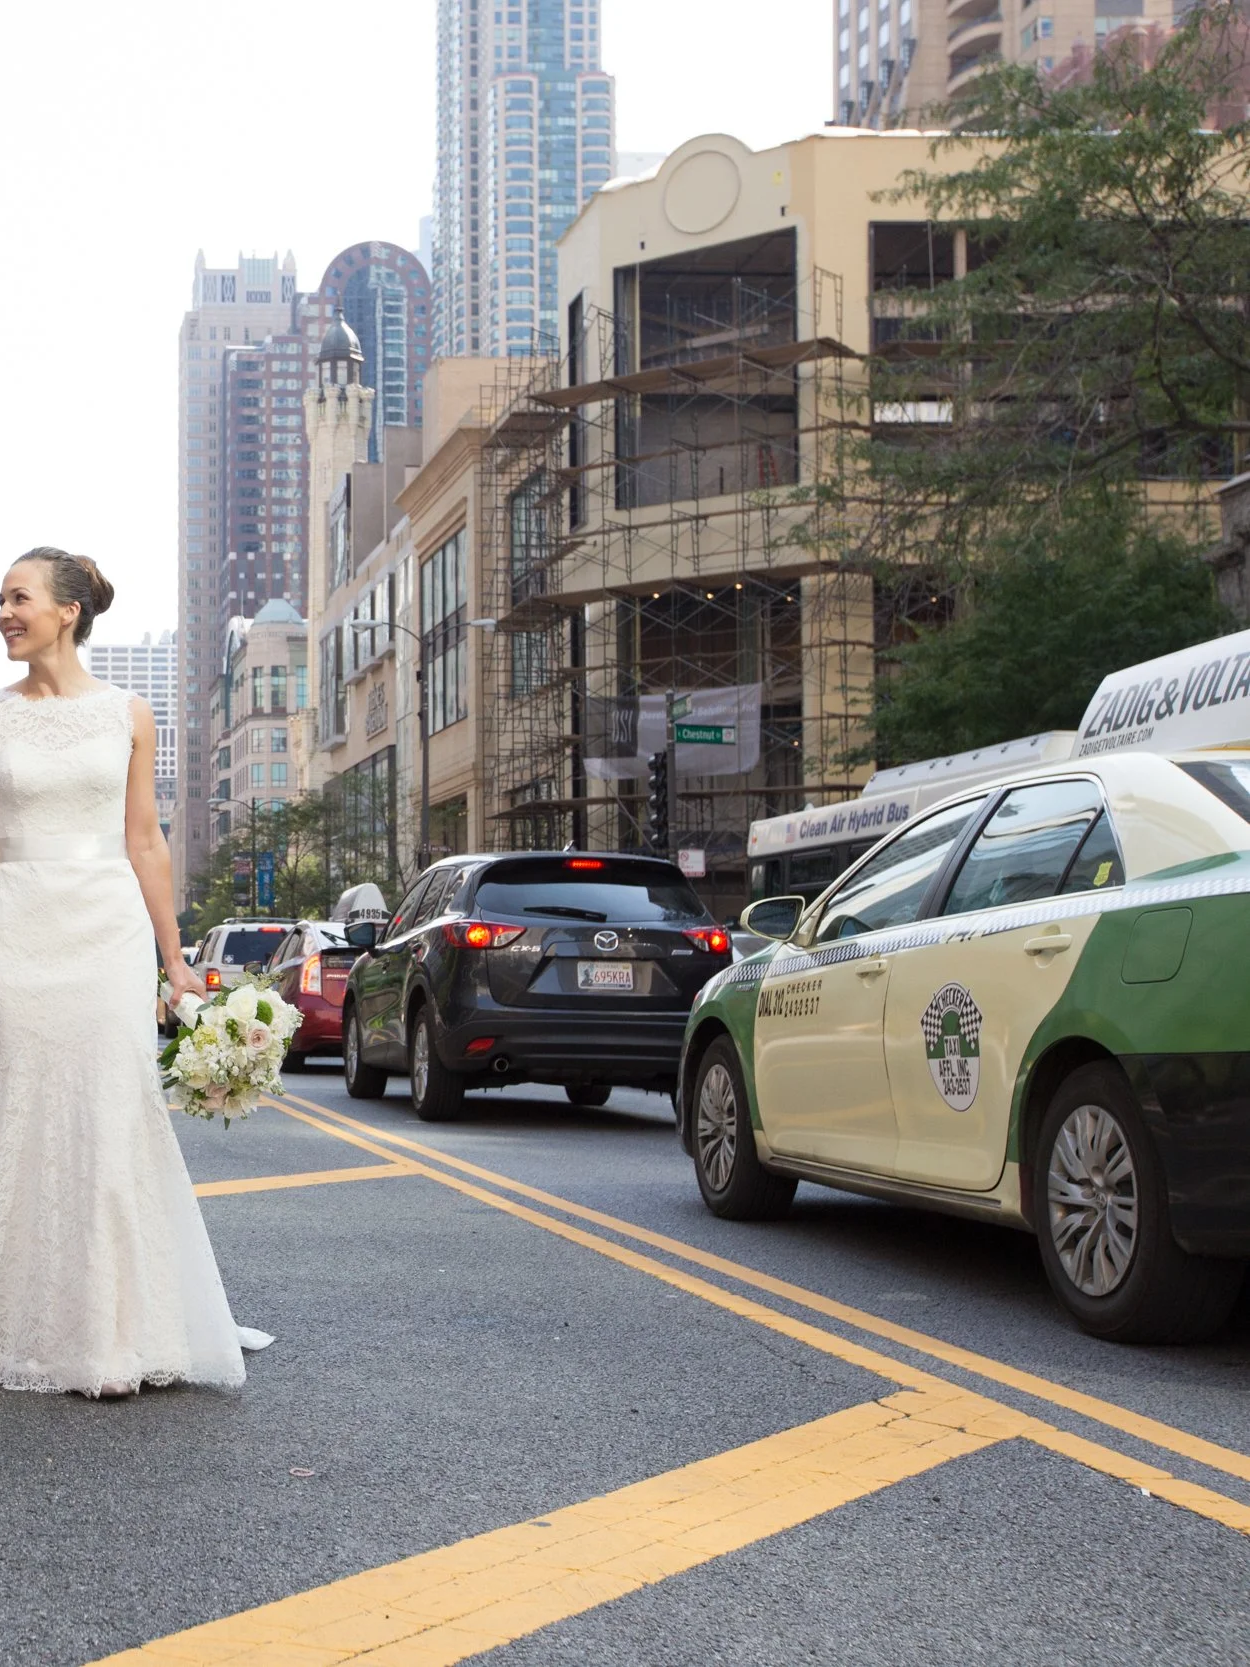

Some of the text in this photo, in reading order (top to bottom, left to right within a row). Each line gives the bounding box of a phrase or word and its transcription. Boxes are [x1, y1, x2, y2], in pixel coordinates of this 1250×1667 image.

[682, 729, 715, 740] Chestnut
[1078, 727, 1154, 757] ZADIGETVOLTAIRE.COM
[800, 802, 910, 839] Clean Air Hybrid Bus
[360, 908, 381, 919] 4935
[594, 970, 631, 984] 695KRA
[786, 979, 822, 995] CHECKER
[758, 990, 773, 1018] DIAL
[773, 988, 785, 1016] 312
[936, 987, 965, 1012] CHECKER
[944, 1038, 959, 1056] TAXI
[939, 1059, 971, 1077] AFFL. INC.
[942, 1078, 970, 1096] 243-2537
